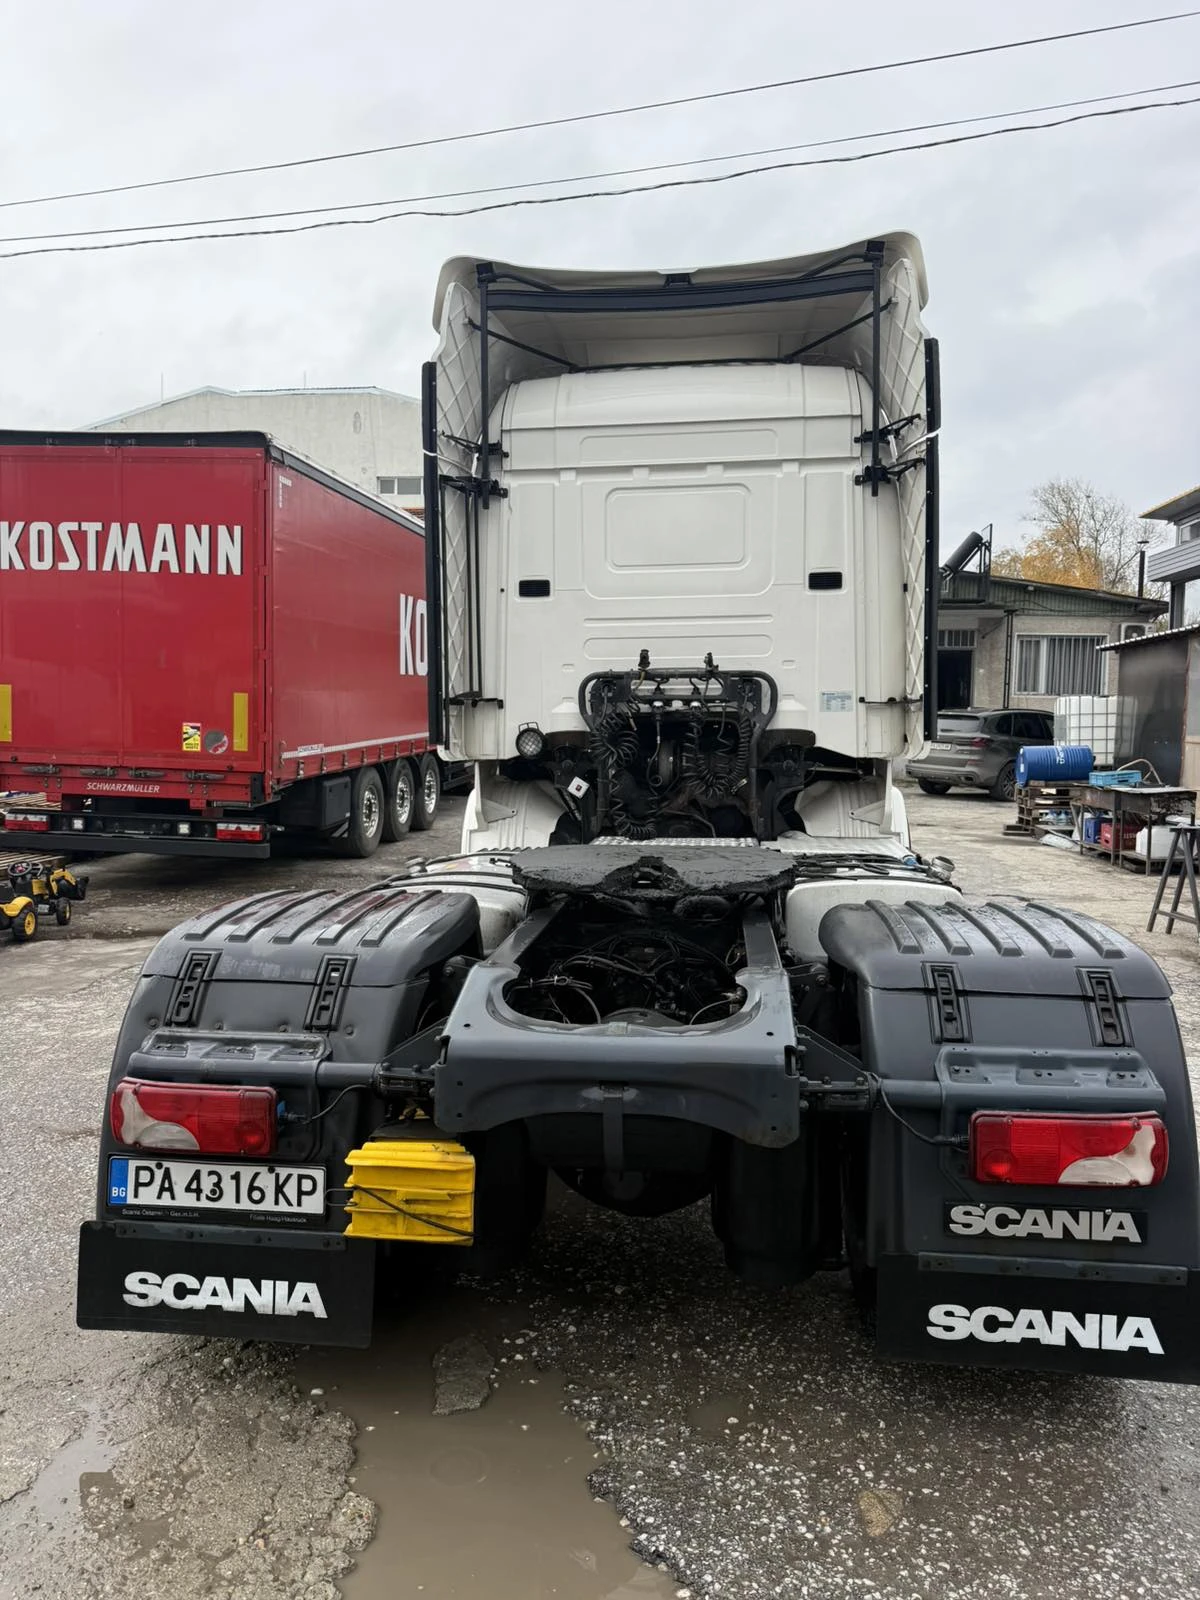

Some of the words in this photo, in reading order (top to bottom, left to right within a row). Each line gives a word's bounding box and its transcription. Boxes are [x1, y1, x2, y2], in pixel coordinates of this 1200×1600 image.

[0, 521, 242, 575] KOSTMANN
[112, 1186, 126, 1198] BG
[949, 1204, 1142, 1243] SCANIA
[123, 1271, 328, 1319] SCANIA
[926, 1304, 1165, 1354] SCANIA
